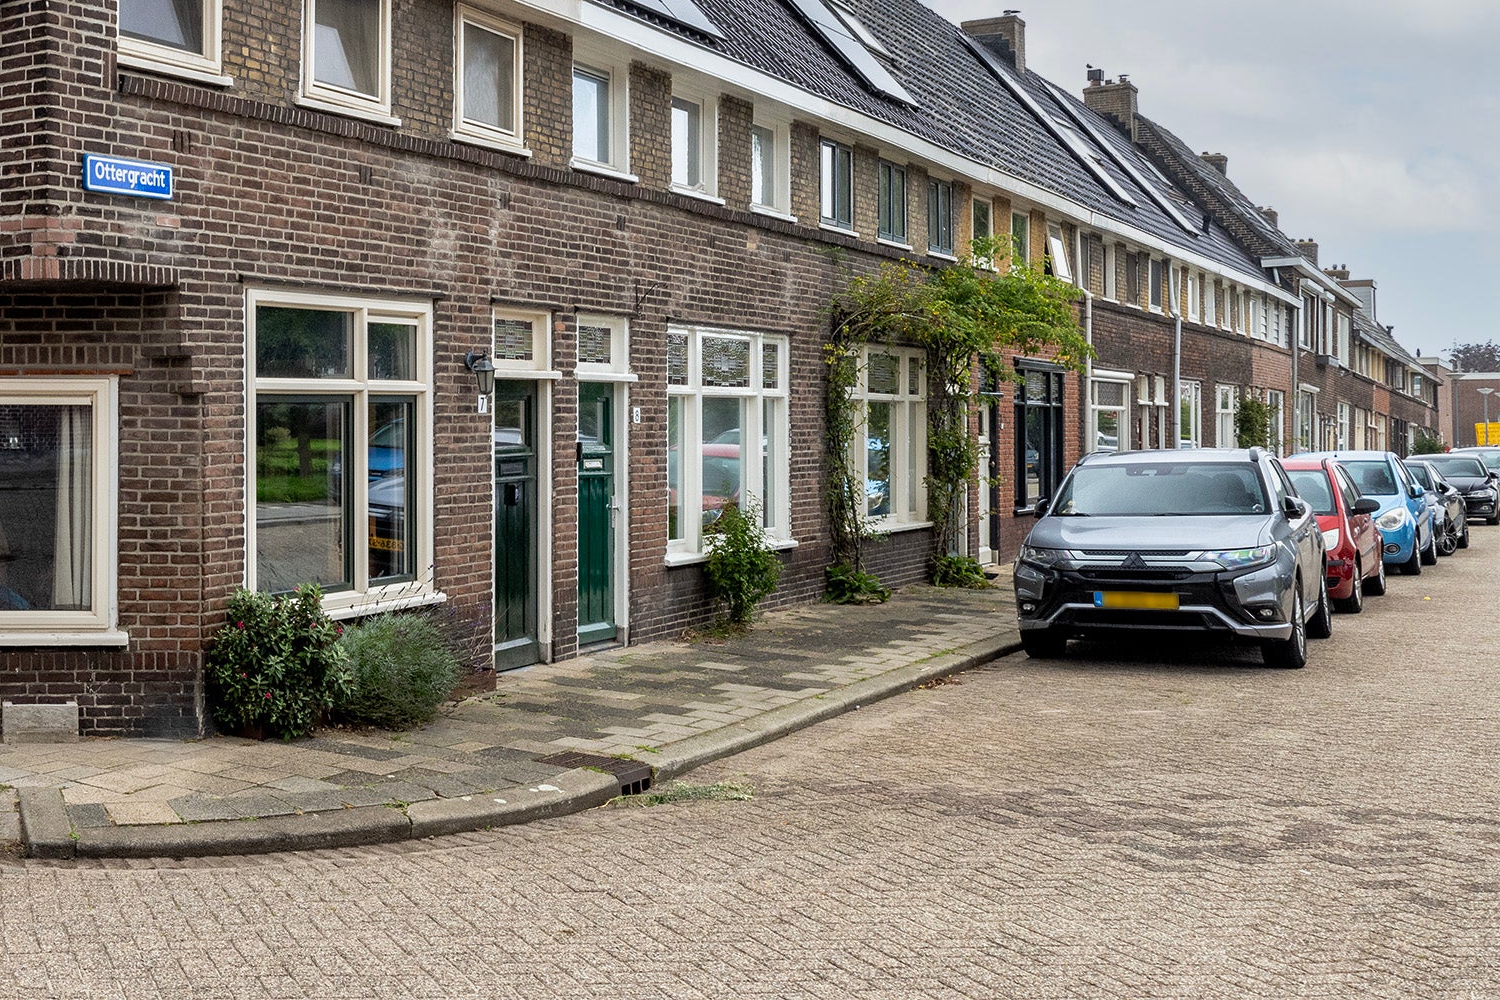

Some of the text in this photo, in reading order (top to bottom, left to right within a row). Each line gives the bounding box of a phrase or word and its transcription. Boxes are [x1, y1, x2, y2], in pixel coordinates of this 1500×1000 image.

[94, 161, 166, 189] Ottergracht
[480, 397, 485, 411] 7
[634, 409, 640, 422] 8
